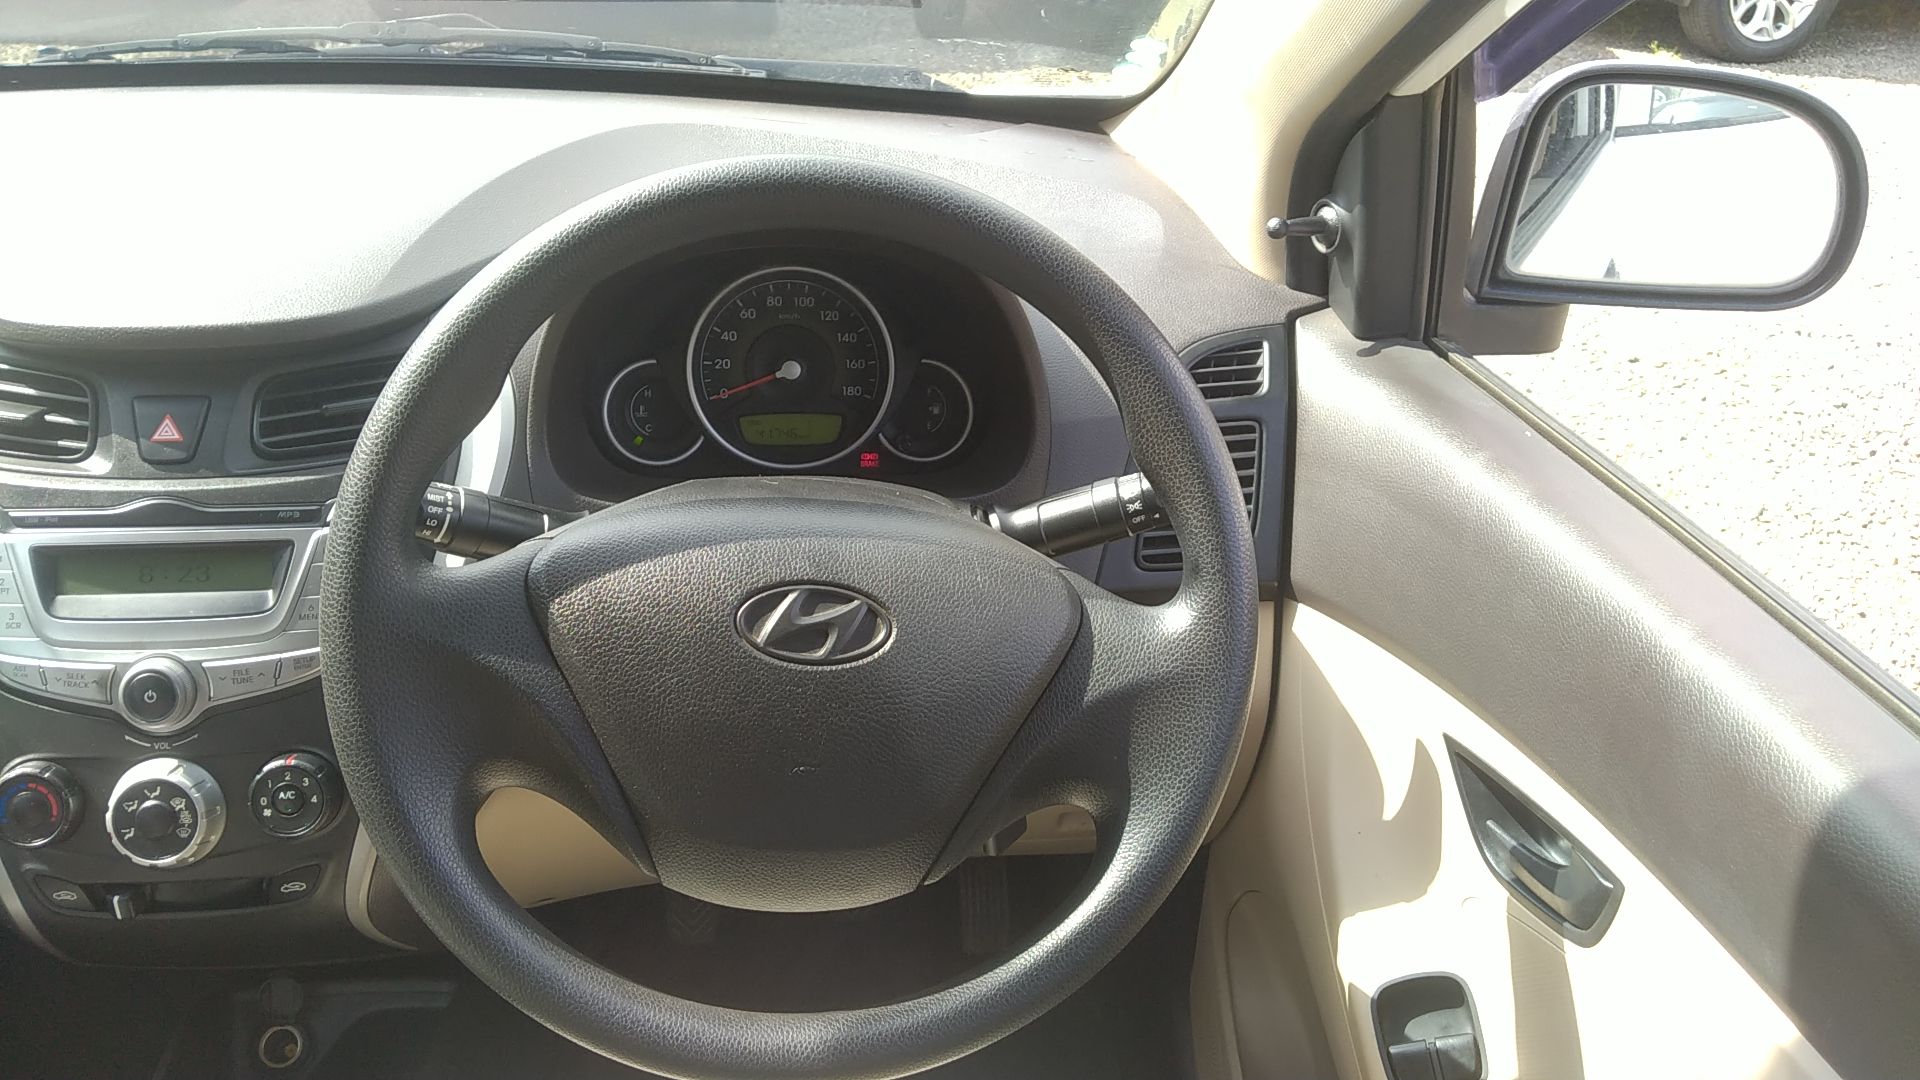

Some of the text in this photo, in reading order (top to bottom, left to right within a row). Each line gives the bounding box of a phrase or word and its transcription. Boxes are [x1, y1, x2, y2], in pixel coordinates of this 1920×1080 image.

[766, 296, 782, 307] 80
[794, 296, 815, 307] 100
[739, 308, 756, 319] 60
[820, 310, 839, 321] 120
[721, 331, 737, 342] 40
[837, 332, 857, 343] 140
[715, 359, 731, 369] 20
[846, 359, 865, 369] 160
[842, 386, 862, 396] 180
[427, 493, 445, 503] MIST
[427, 505, 443, 515] OFF
[426, 518, 438, 527] LO
[1131, 514, 1146, 524] OFF
[9, 612, 15, 621] 3
[299, 613, 319, 621] MEN
[66, 672, 86, 680] SEEK
[232, 668, 251, 677] FILE
[63, 680, 90, 689] TRACK
[231, 676, 254, 686] TUNE
[153, 741, 172, 750] VOL
[284, 771, 291, 780] 2
[267, 780, 272, 789] 1
[302, 777, 309, 786] 3
[278, 790, 296, 800] A/C
[310, 794, 318, 803] 4
[260, 796, 268, 806] 0
